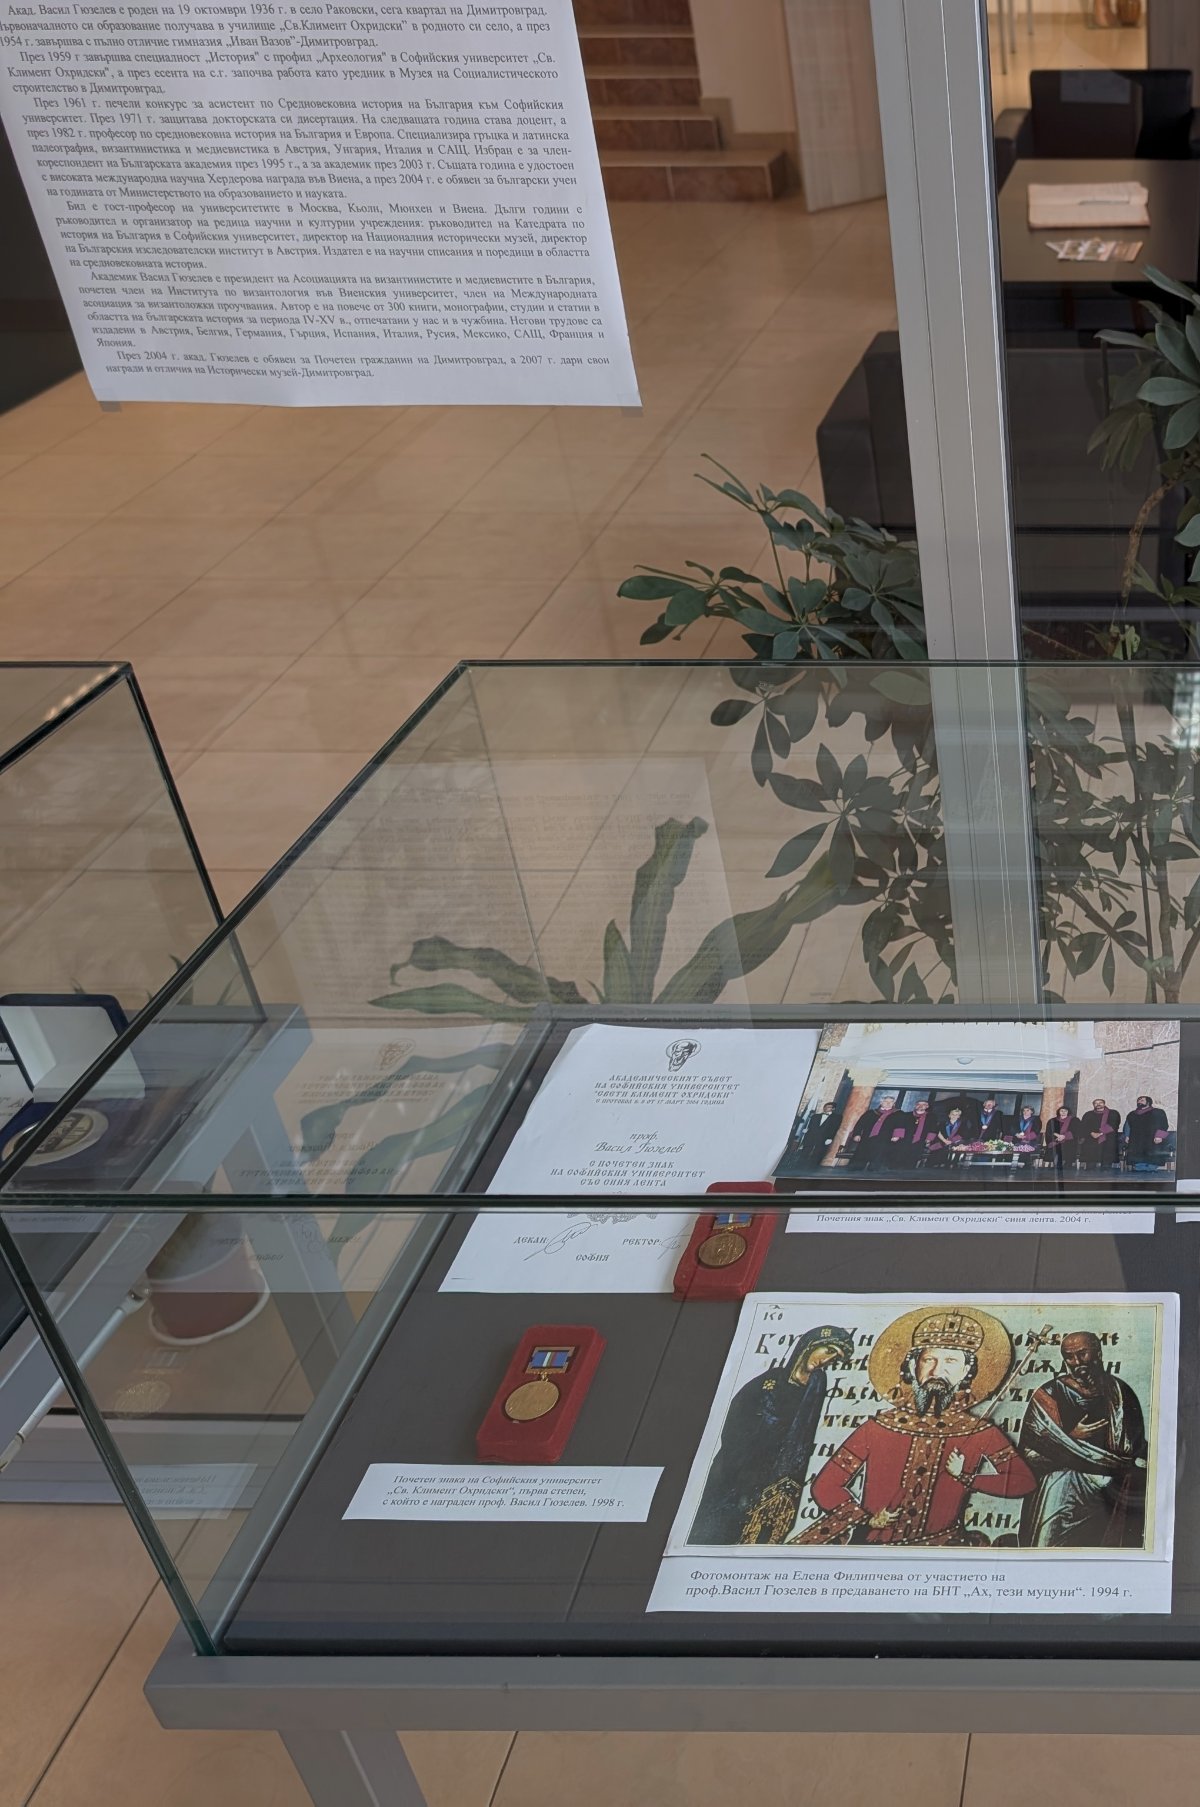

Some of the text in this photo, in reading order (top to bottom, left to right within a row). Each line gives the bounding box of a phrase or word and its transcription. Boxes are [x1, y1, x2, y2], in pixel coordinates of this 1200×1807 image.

[7, 4, 548, 18] Акад. Васил Гюзелев е роден на 19 октомври 1936 г. в село Раковски, сега квартал на Димитровград.
[24, 39, 33, 47] г.
[36, 39, 83, 49] завършва
[85, 39, 91, 47] с
[93, 39, 125, 47] пълно
[126, 39, 169, 47] отличие
[172, 39, 222, 47] гимназия
[225, 37, 258, 49] „Иван
[11, 83, 166, 96] строителство в Димитровград.
[104, 365, 376, 380] награди и отличия на Исторически музей-Димитровград.
[630, 1131, 658, 1143] проф.
[594, 1141, 685, 1154] Васил Гюзелев
[393, 1475, 436, 1484] Почетен
[480, 1476, 538, 1486] Софийския
[538, 1478, 603, 1487] университет
[389, 1497, 421, 1506] който
[429, 1499, 476, 1508] награден
[476, 1498, 508, 1509] проф.
[508, 1498, 541, 1507] Васил
[541, 1498, 590, 1507] Гюзелев.
[590, 1498, 615, 1507] 1998
[689, 1570, 1006, 1585] Фотомонтаж на Елена Филипчева от участието на
[684, 1585, 1134, 1600] проф.Васил Гюзелев в предаването на БНТ „Ах, тези муцуни“. 1994 г.
